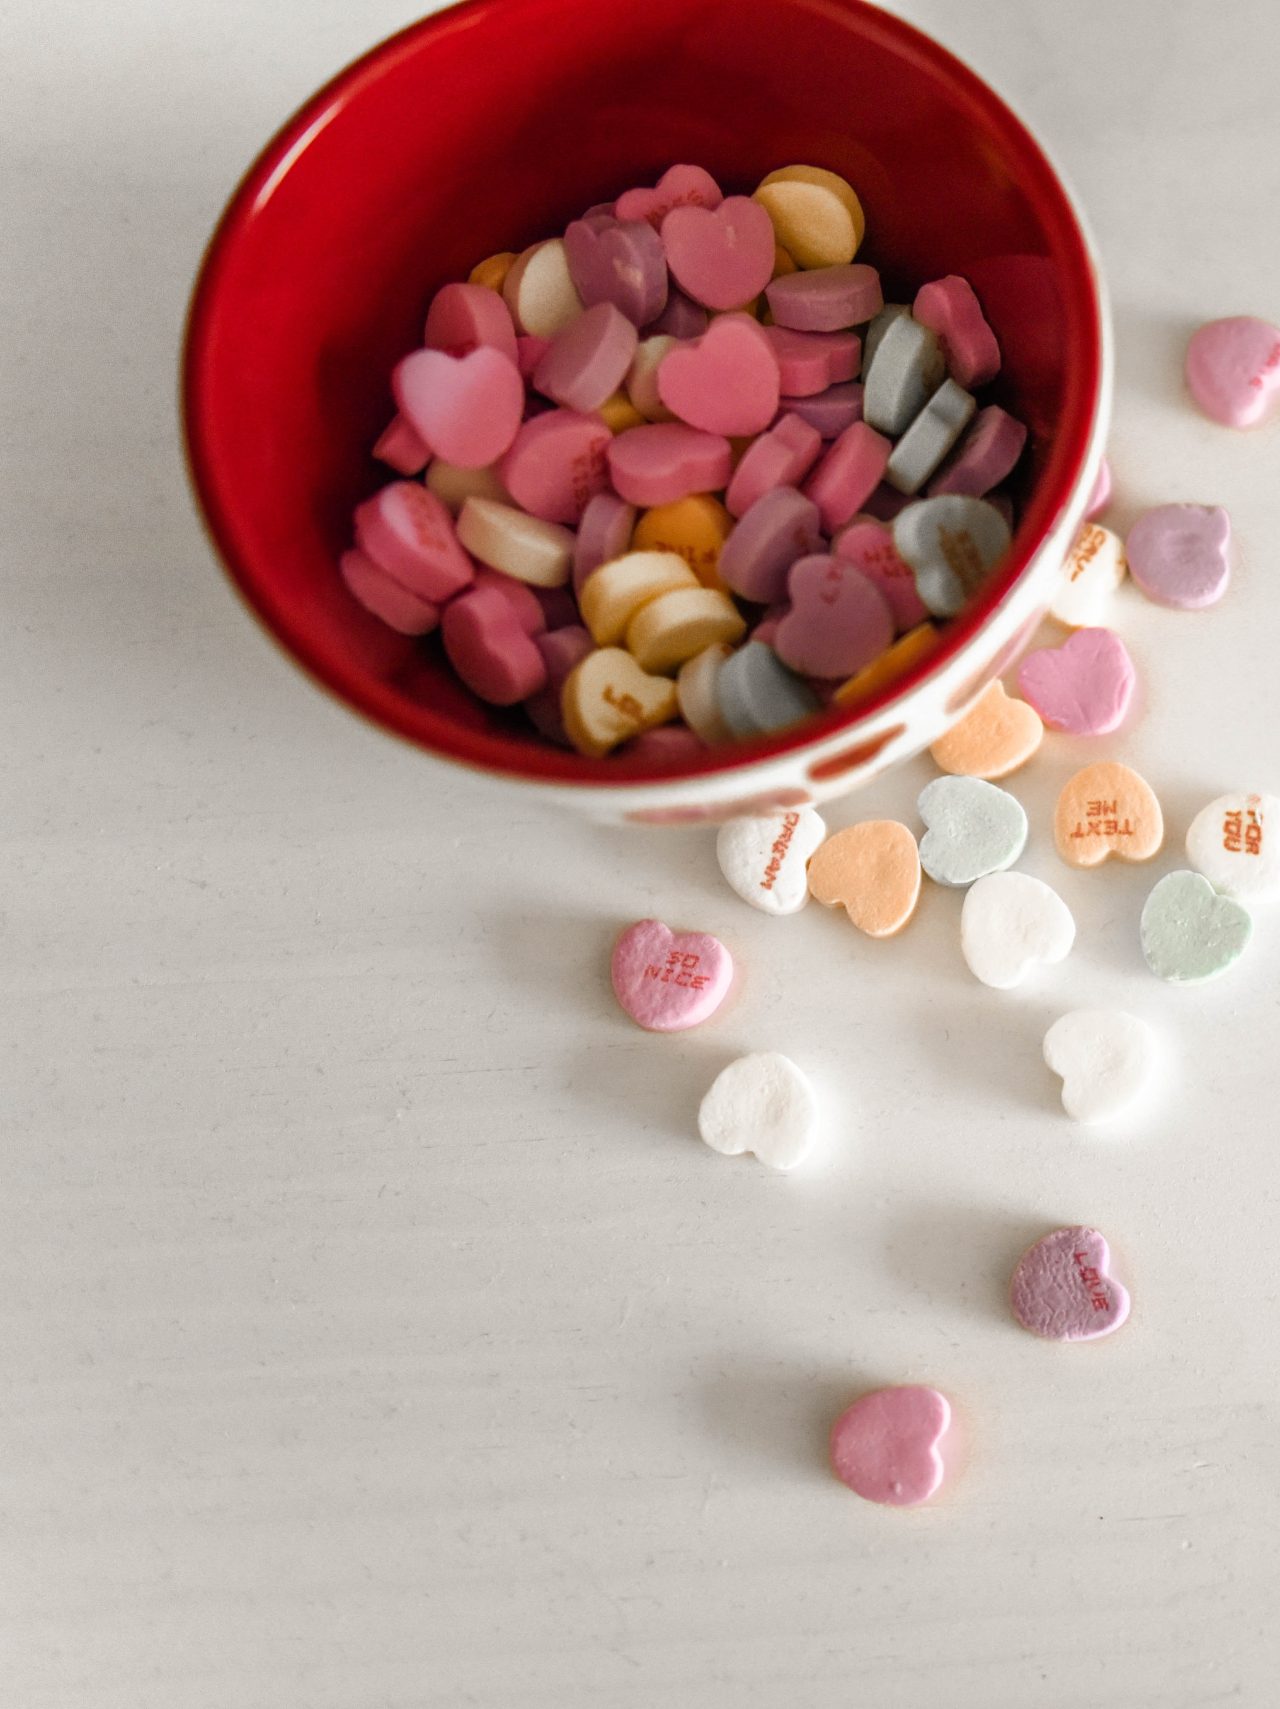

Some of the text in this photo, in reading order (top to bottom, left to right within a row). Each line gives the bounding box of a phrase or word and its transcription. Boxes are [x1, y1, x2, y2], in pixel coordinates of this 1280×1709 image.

[1086, 799, 1117, 817] ME
[1070, 818, 1133, 838] TEXT
[1223, 809, 1241, 852] YOU
[1245, 808, 1262, 855] FOR
[759, 812, 800, 890] DREAM
[644, 964, 710, 991] NICE
[666, 951, 700, 969] SO
[1073, 1251, 1110, 1312] LOVE
